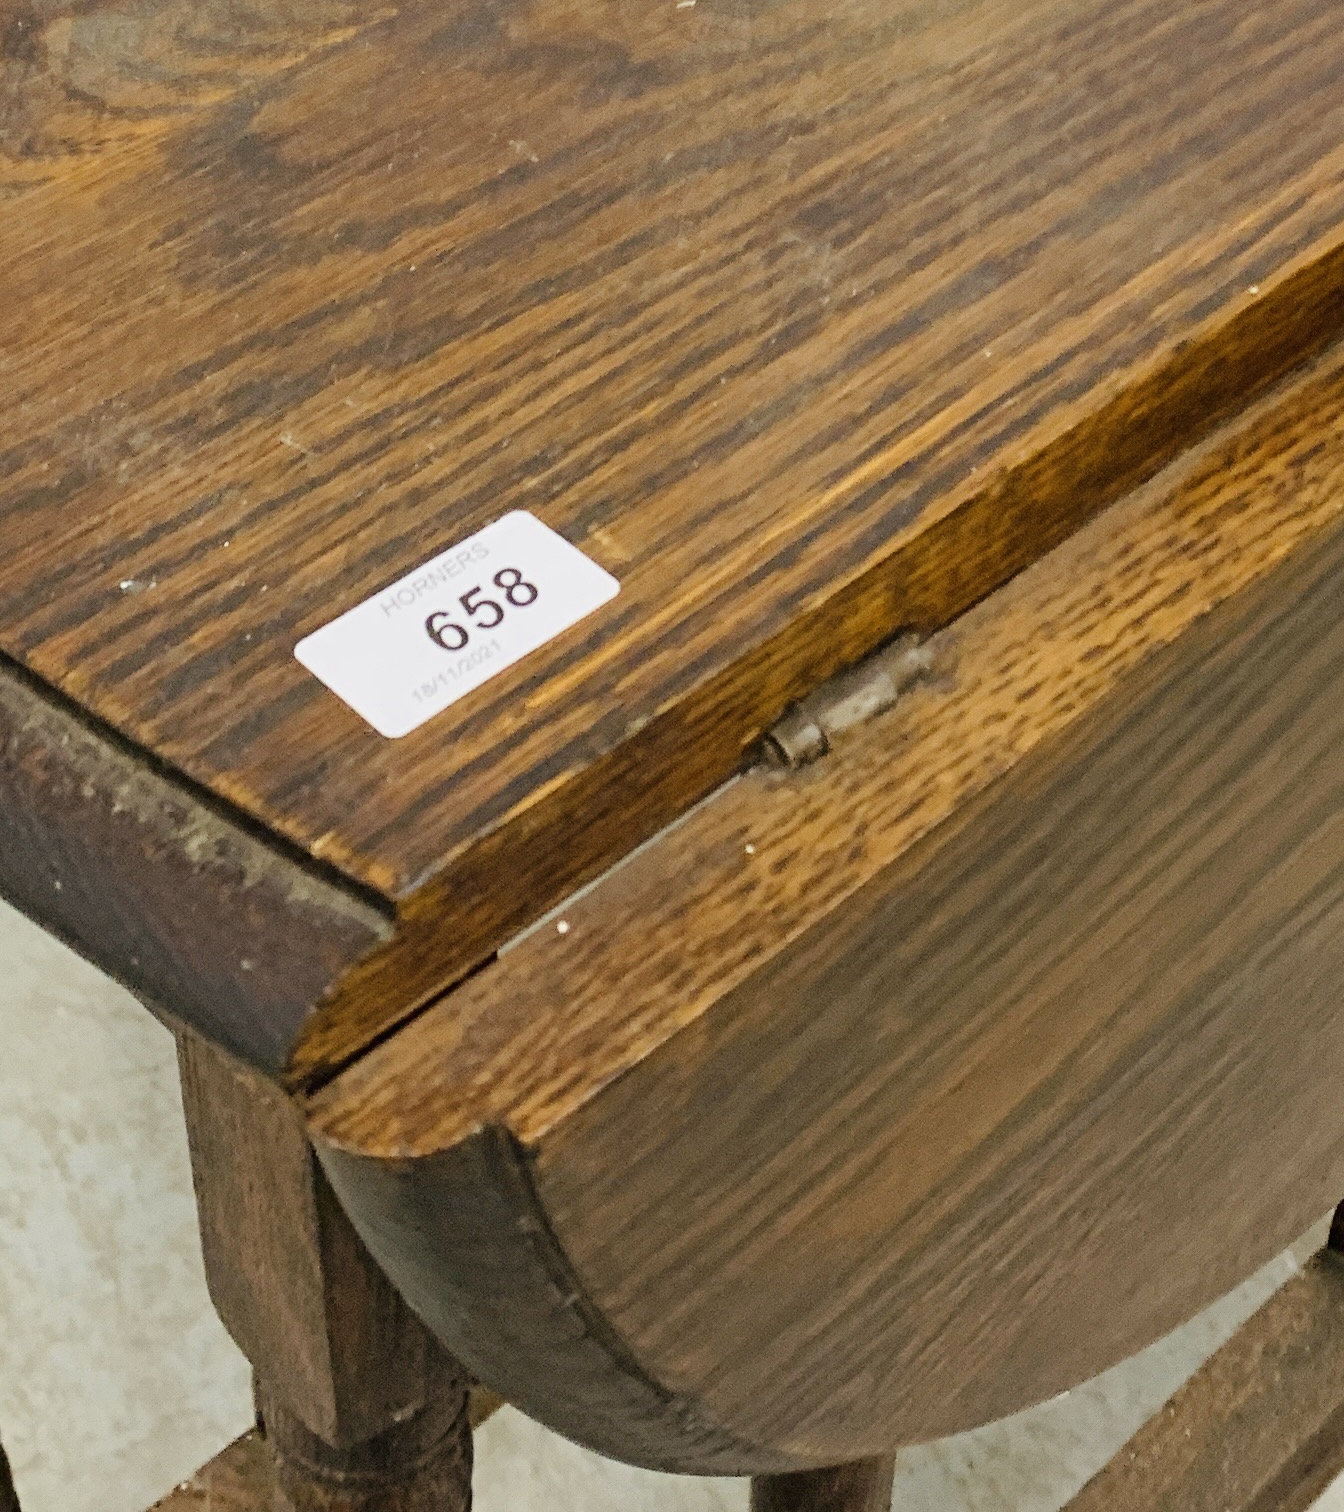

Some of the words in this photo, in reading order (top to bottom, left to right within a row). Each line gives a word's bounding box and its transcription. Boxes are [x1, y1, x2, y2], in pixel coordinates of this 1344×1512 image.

[380, 542, 490, 617] HORNERS
[424, 567, 539, 652] 658
[412, 639, 501, 703] 18/11/2021
